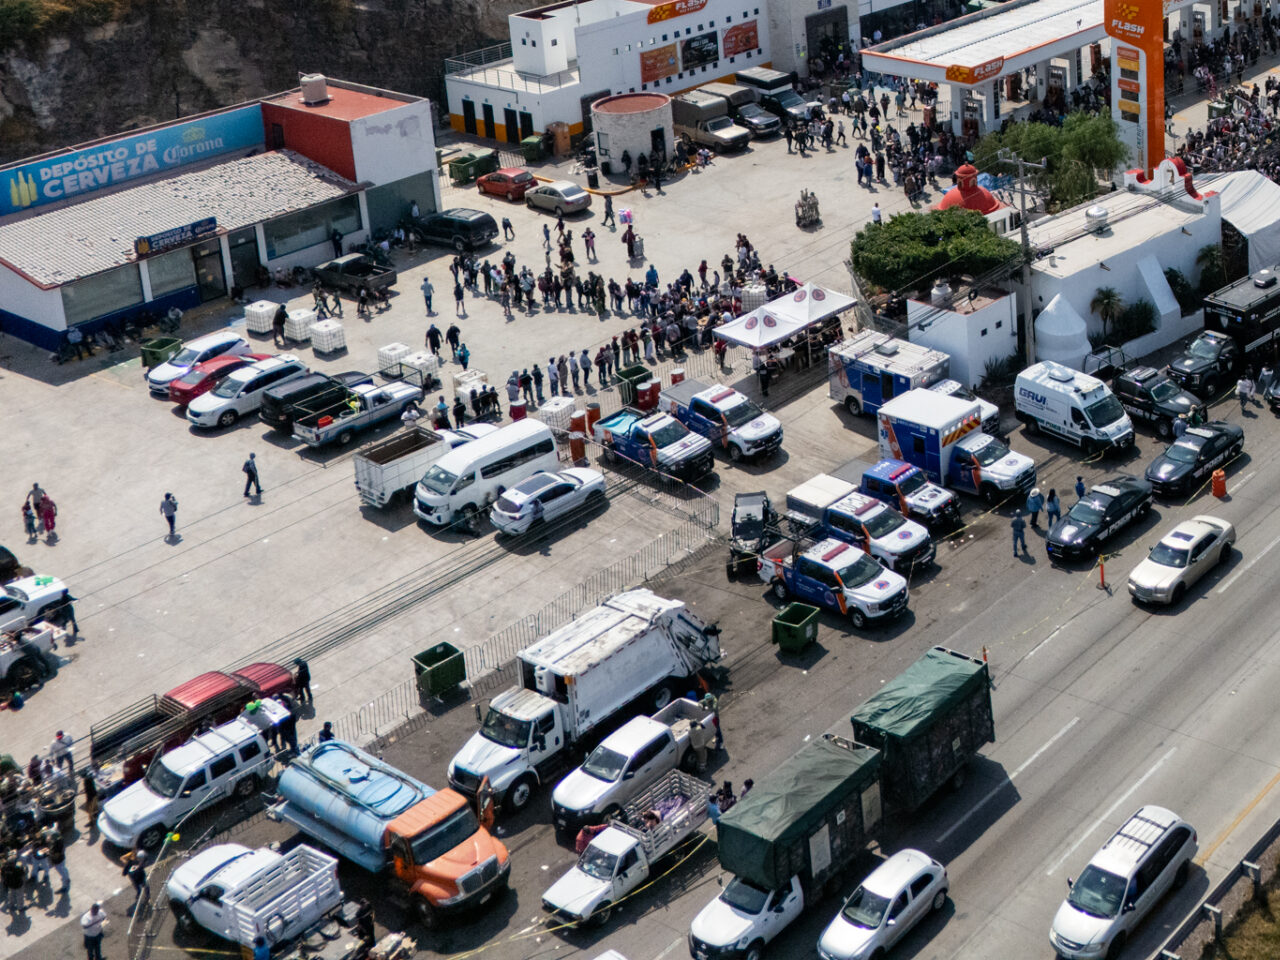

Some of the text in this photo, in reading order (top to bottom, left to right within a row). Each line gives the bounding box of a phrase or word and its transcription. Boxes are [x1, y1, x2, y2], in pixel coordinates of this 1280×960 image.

[40, 136, 224, 182] DEPÓSITO DE Corona
[43, 153, 159, 198] CERVEZA
